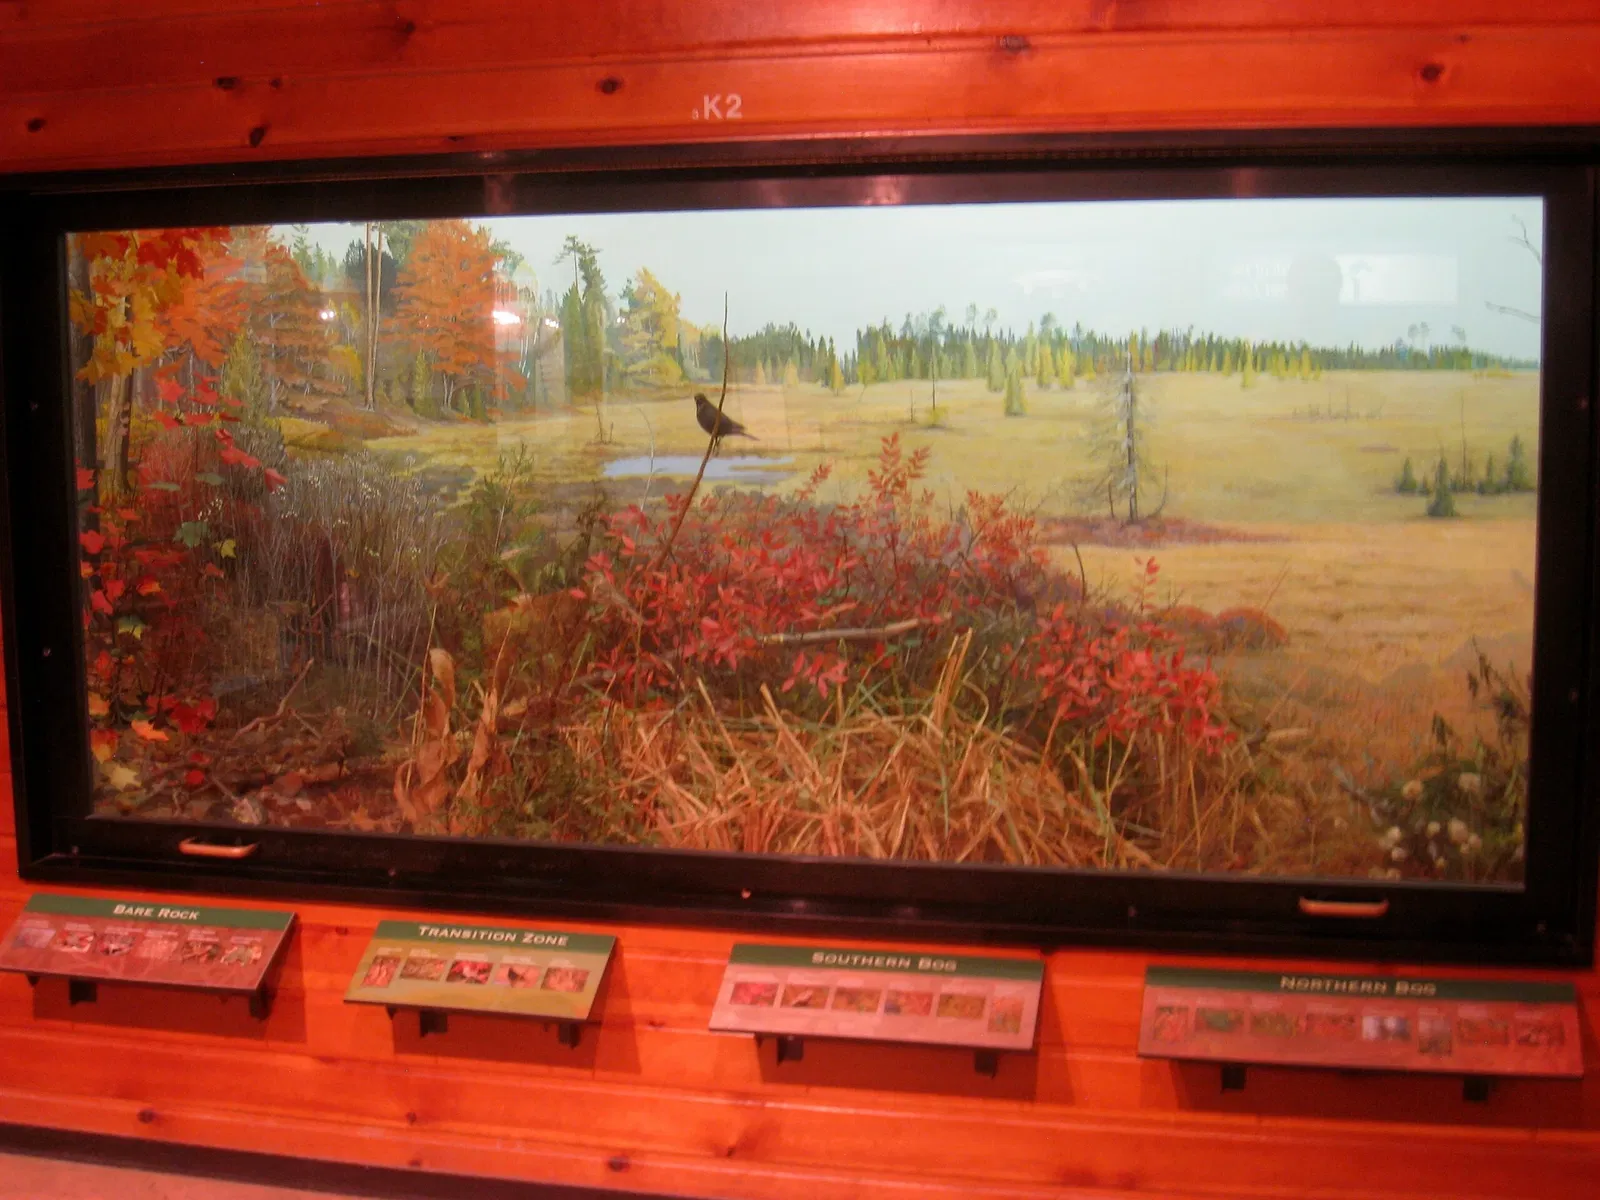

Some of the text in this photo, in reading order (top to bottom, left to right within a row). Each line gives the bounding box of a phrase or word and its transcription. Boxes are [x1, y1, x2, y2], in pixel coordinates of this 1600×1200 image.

[703, 93, 743, 120] K2
[113, 904, 200, 921] BARE ROCK
[418, 925, 570, 947] TRANSITION ZONE
[811, 951, 911, 970] SOUTHERN
[1280, 975, 1388, 995] NORTHERN
